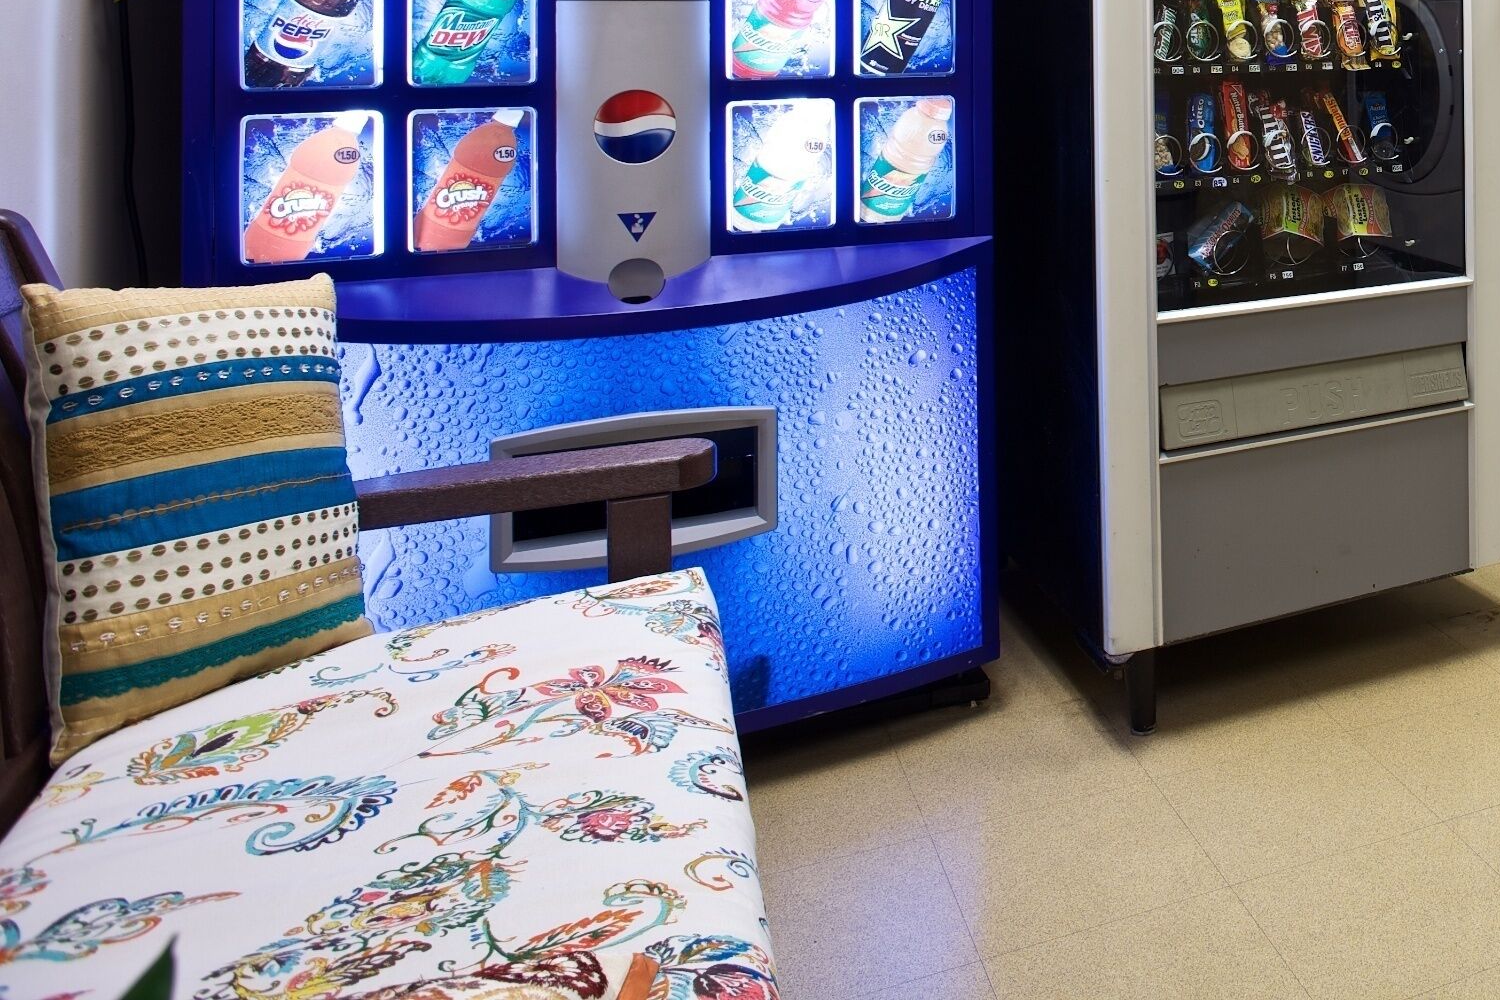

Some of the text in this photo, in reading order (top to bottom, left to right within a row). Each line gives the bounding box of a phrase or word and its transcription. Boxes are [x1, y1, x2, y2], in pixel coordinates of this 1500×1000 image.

[272, 18, 331, 39] PEPSI
[1197, 99, 1205, 128] OREO
[436, 185, 488, 209] Crush
[1280, 376, 1369, 425] PUSH
